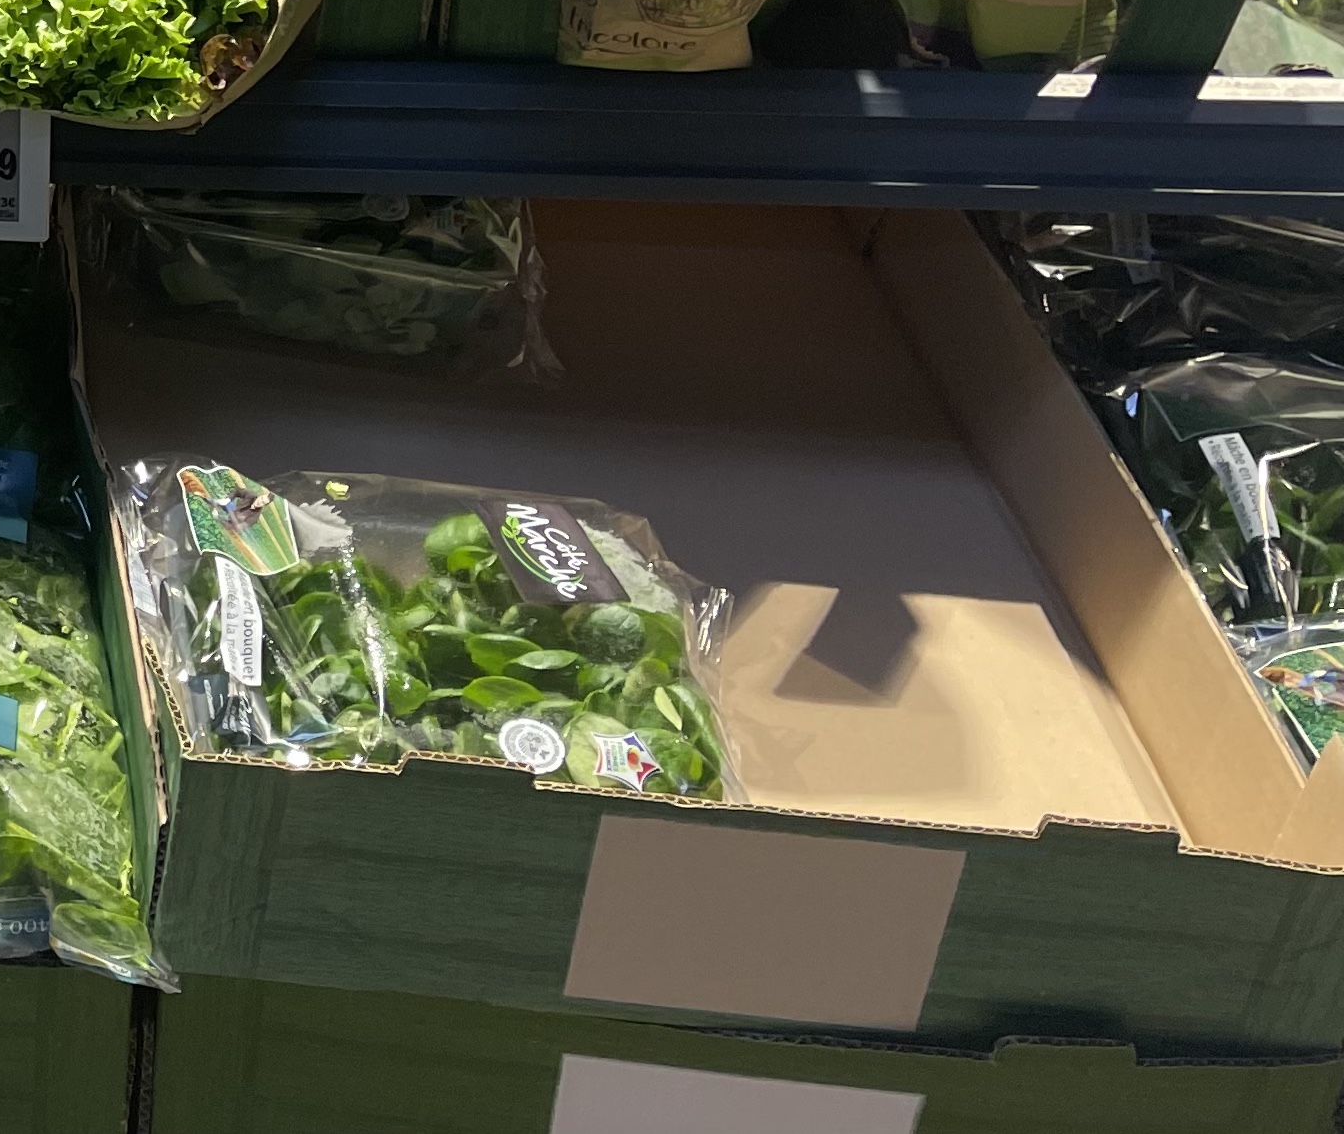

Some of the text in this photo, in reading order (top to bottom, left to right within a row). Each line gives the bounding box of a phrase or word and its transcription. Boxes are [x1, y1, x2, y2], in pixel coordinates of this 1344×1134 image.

[506, 504, 588, 599] Marché
[544, 528, 589, 570] Côté
[241, 619, 257, 681] bouquet
